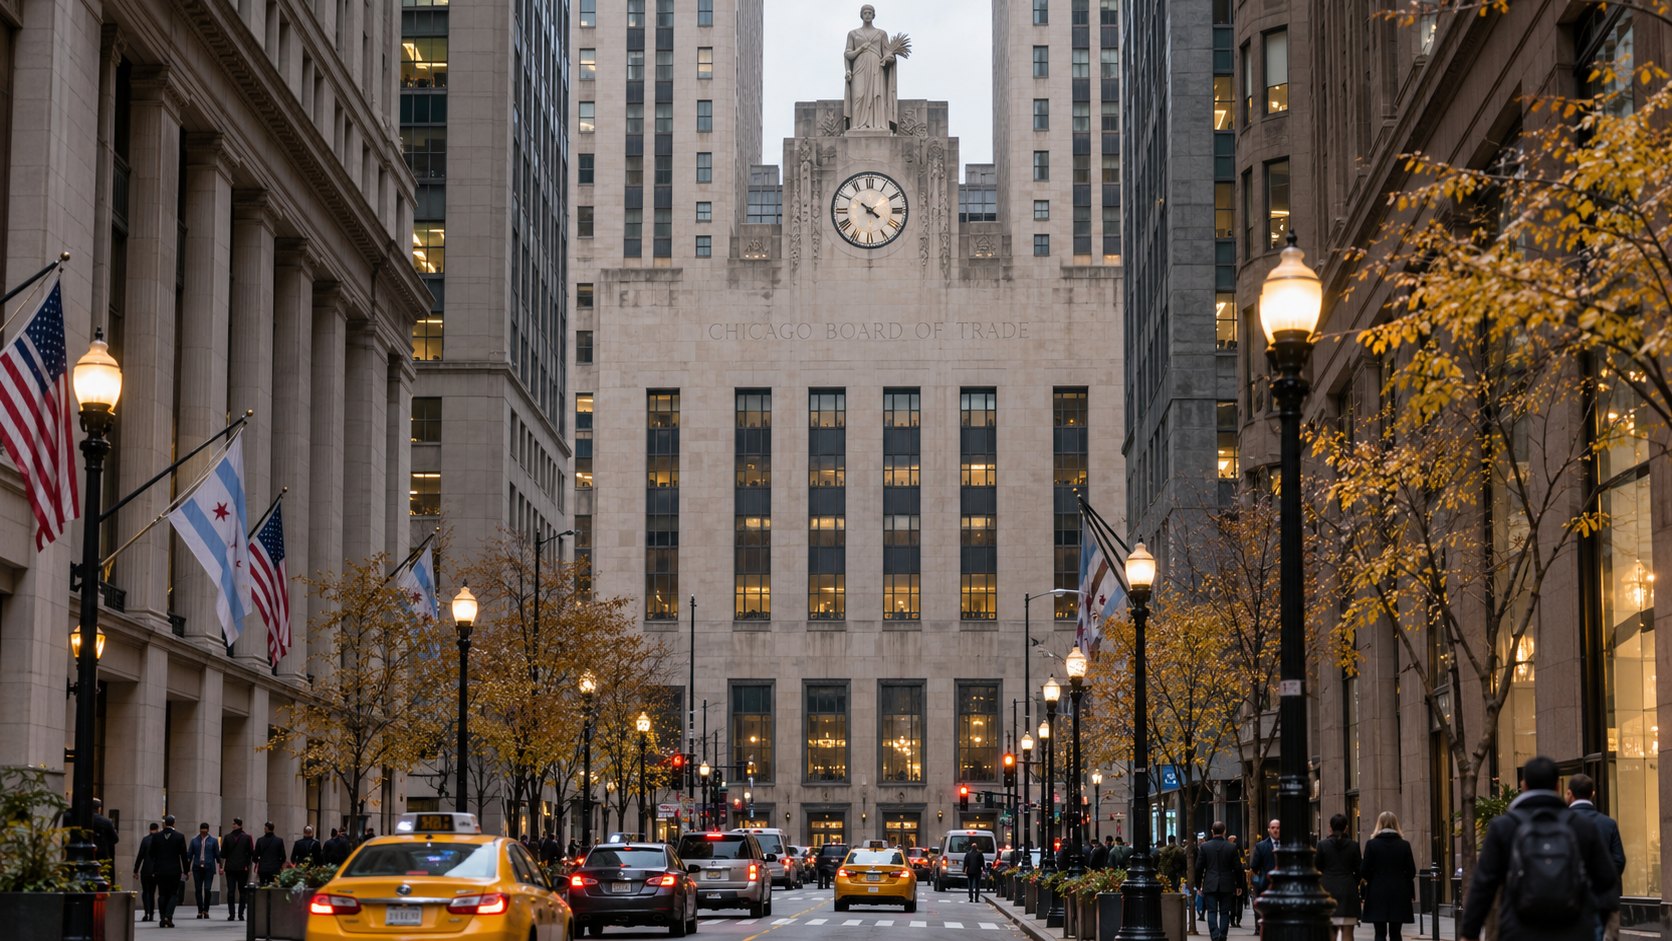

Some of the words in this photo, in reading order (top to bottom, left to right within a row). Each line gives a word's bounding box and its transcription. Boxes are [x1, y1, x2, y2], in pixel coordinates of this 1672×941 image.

[708, 322, 812, 341] CHICAGO
[826, 322, 903, 340] BOARD
[914, 321, 944, 340] OF
[955, 321, 1030, 340] TRADE
